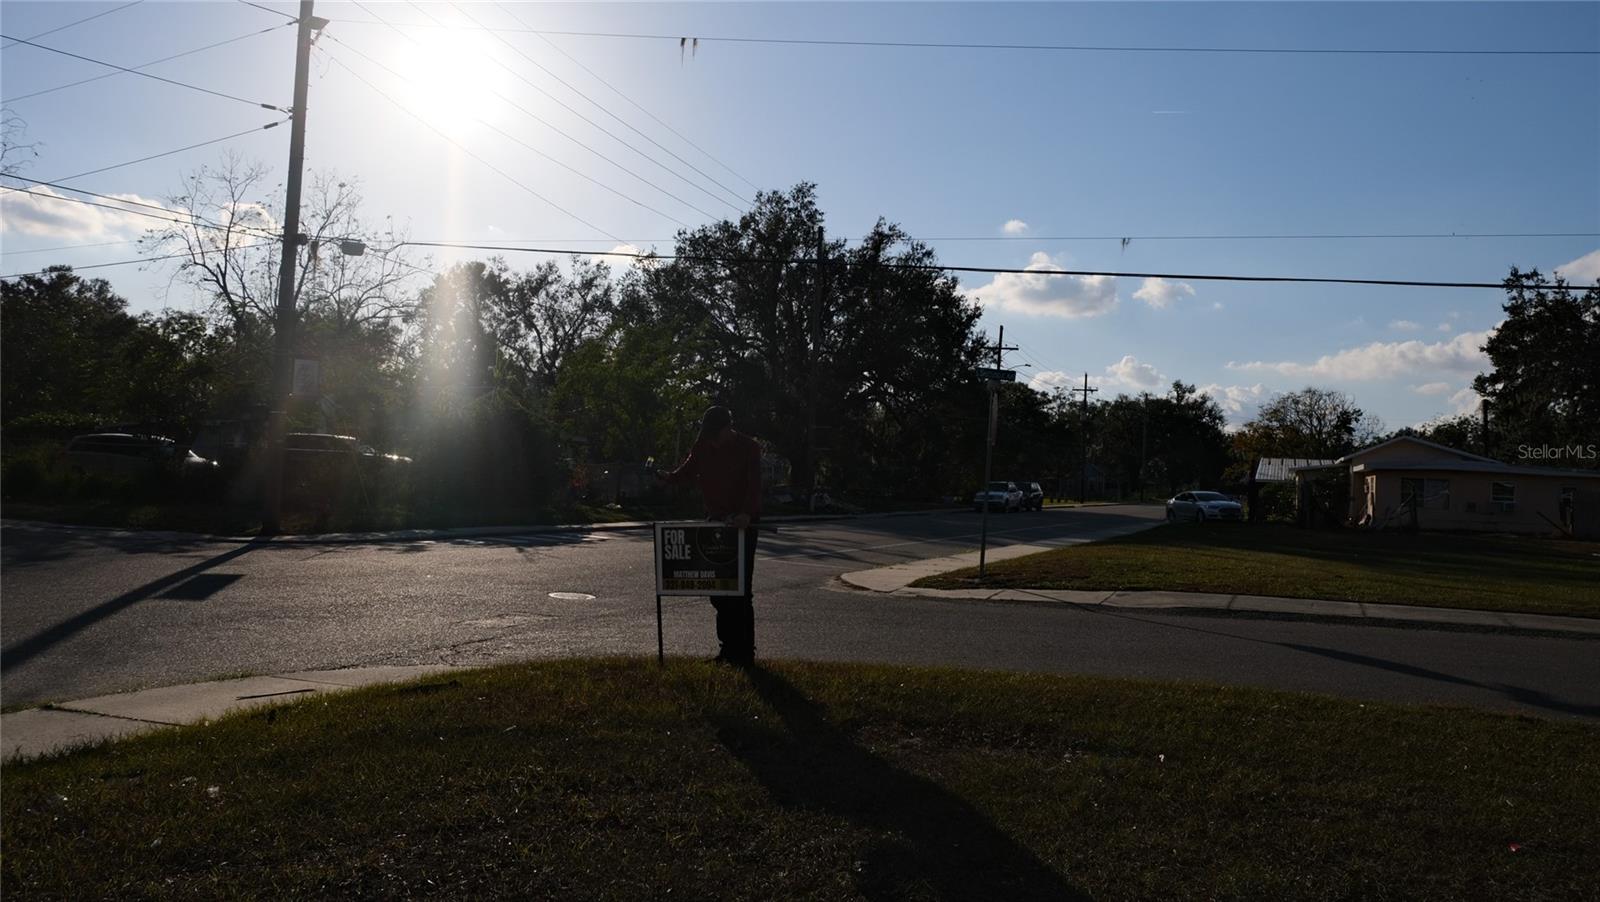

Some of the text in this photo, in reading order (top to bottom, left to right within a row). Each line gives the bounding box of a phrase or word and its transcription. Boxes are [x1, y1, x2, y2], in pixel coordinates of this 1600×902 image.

[664, 529, 685, 545] FOR
[664, 544, 692, 560] SALE
[673, 570, 699, 578] MATTHEW
